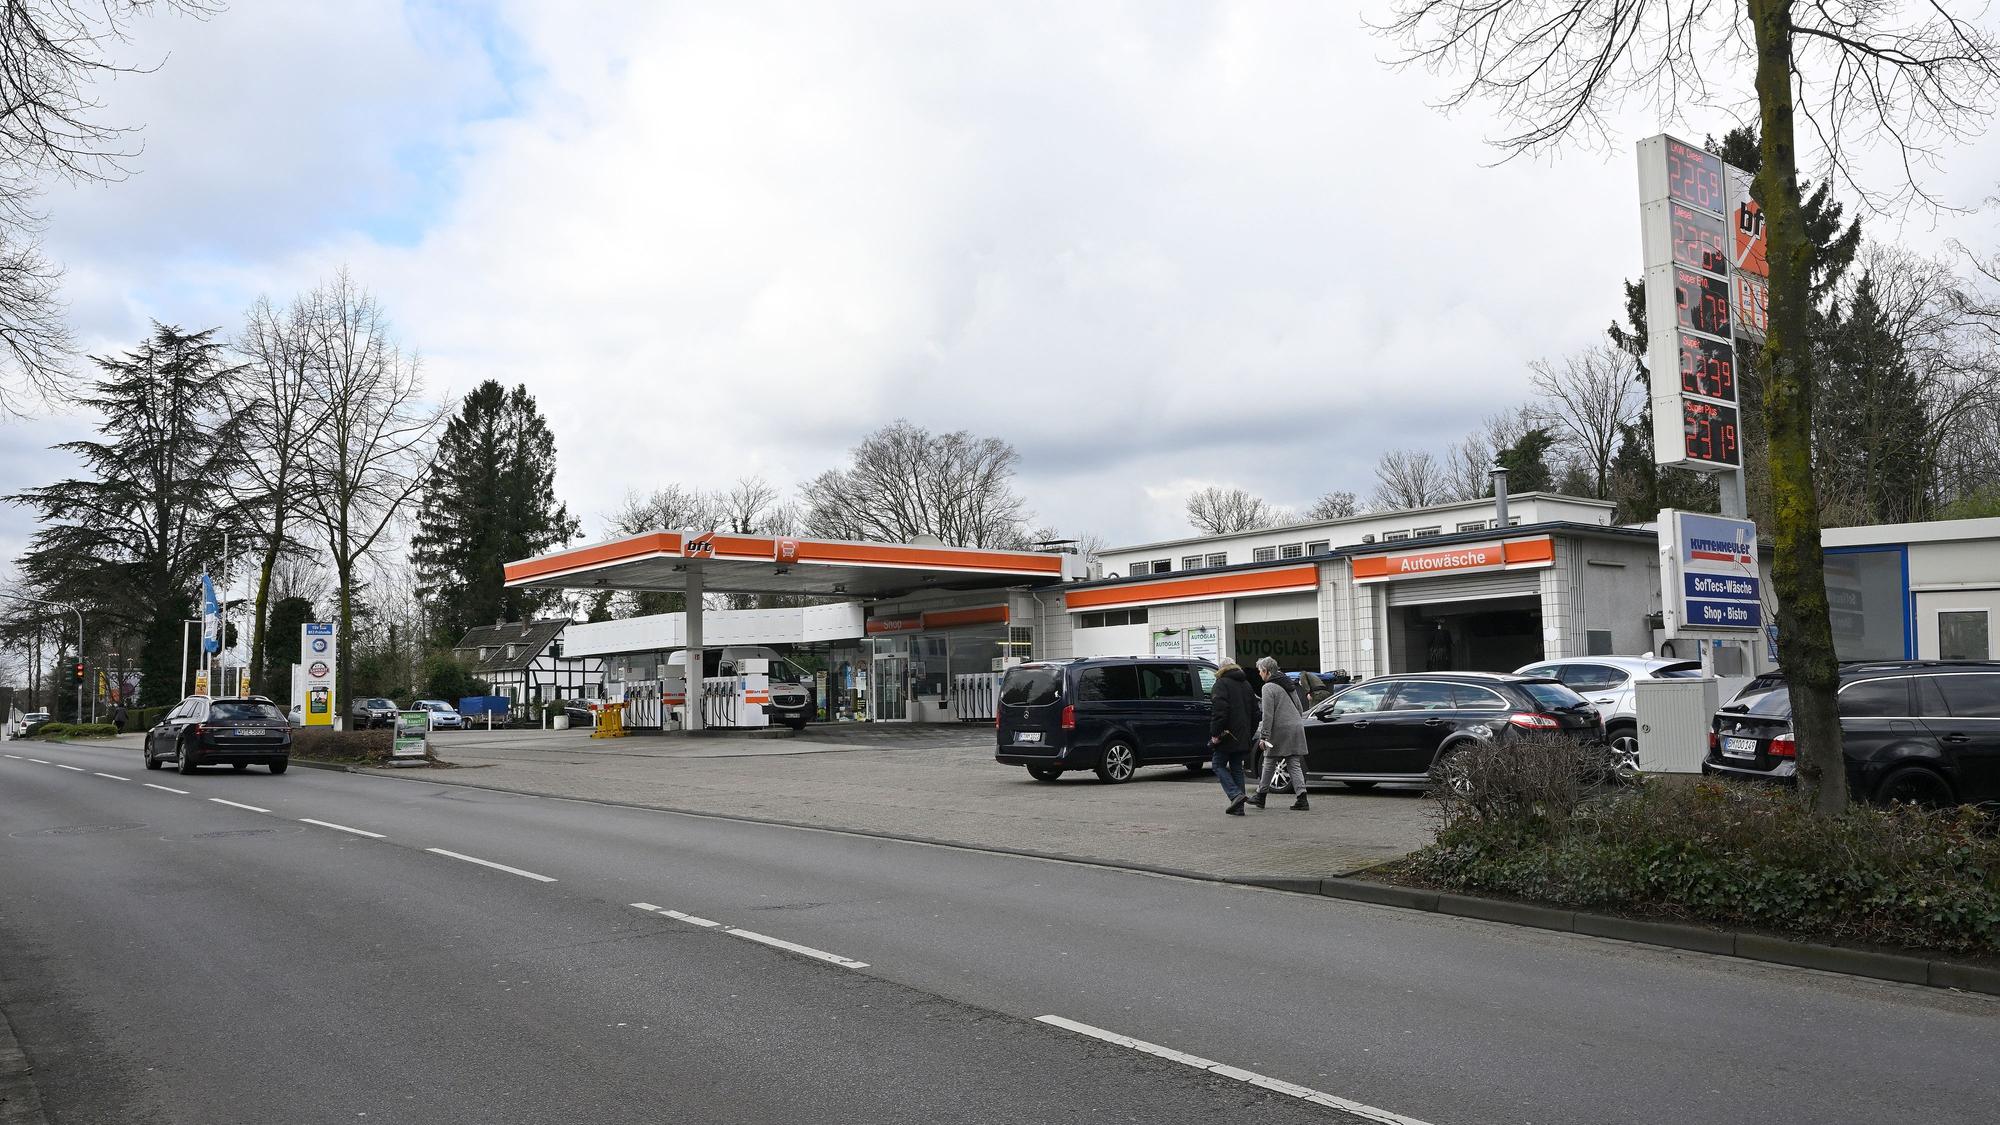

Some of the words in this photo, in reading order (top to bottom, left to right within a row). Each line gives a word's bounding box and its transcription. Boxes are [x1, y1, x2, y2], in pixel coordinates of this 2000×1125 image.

[1740, 201, 1765, 238] bf
[1679, 271, 1696, 284] Super
[1687, 402, 1705, 416] Super
[1705, 405, 1718, 417] Plus
[1401, 552, 1486, 572] Autowäsche
[1694, 578, 1752, 595] SofTecs-Wäsche
[1703, 605, 1722, 621] Shop
[1727, 607, 1748, 621] Bistro
